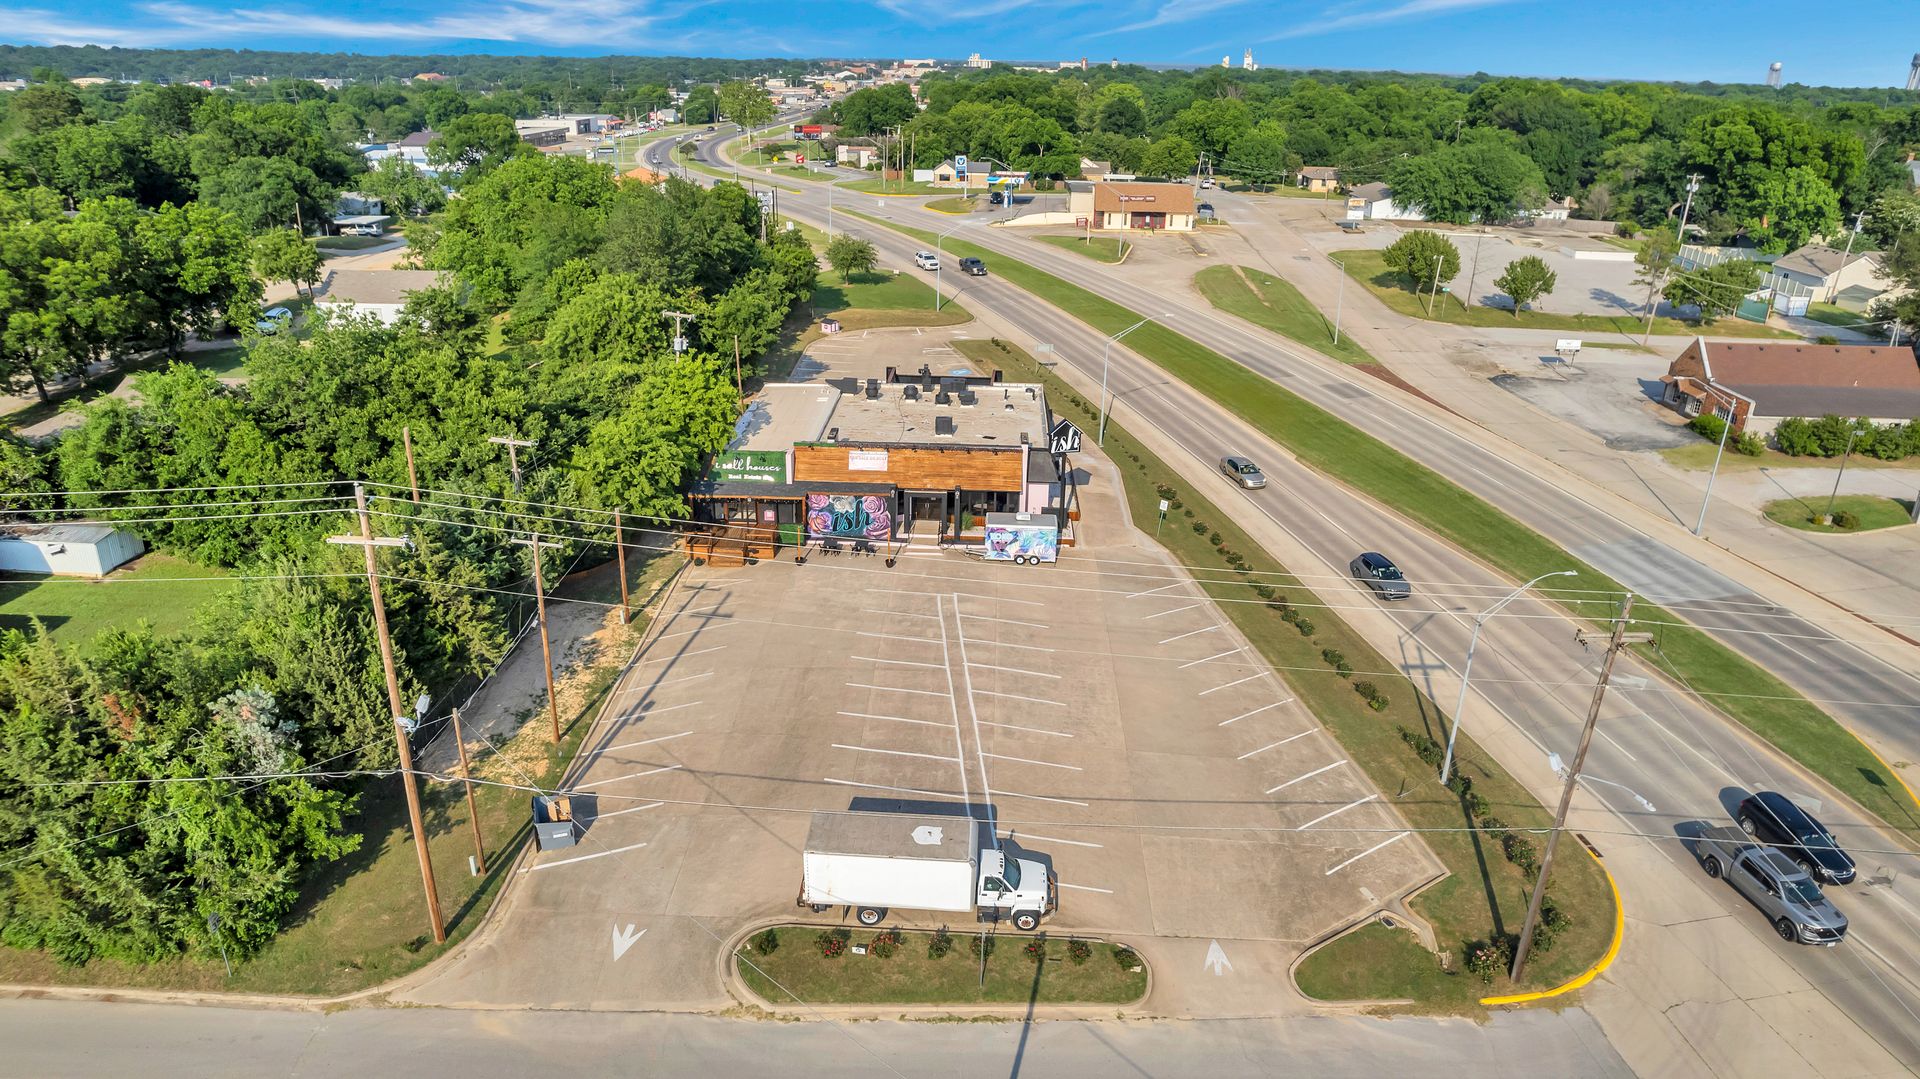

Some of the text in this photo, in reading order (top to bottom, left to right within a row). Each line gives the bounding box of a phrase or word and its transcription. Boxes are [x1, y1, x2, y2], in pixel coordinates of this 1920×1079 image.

[1051, 426, 1080, 453] ish
[746, 456, 781, 471] houses
[832, 499, 873, 532] ish
